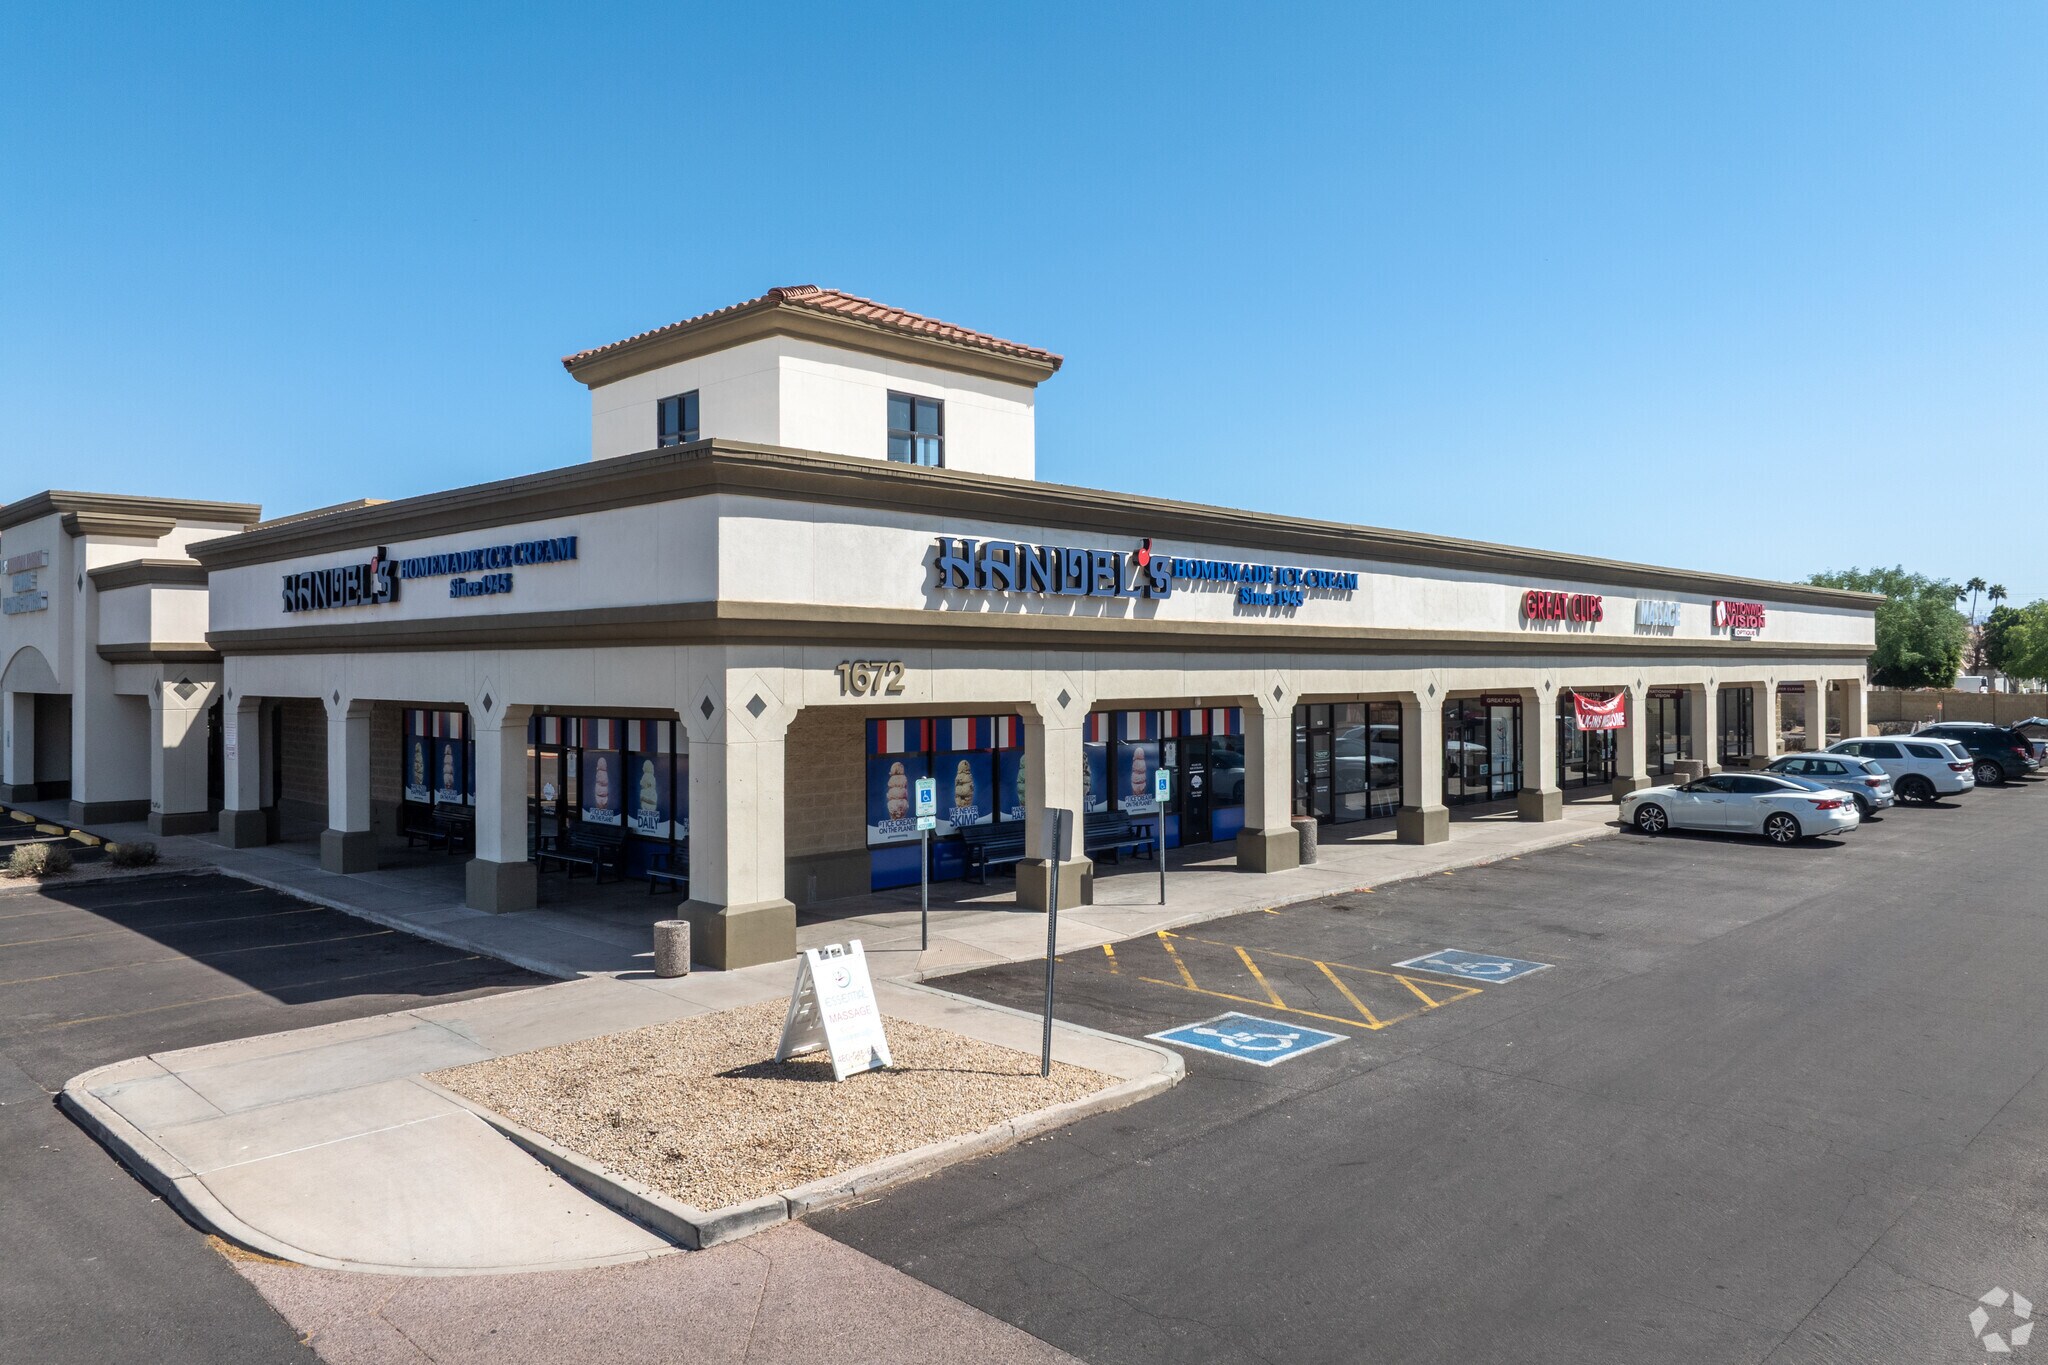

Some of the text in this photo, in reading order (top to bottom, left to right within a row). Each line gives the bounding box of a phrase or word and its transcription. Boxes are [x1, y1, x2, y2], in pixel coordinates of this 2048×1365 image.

[282, 536, 578, 612] HANDEL'S HOMEMADE ICE CREAM
[935, 537, 1359, 600] HANDEL'S HOMEMADE ICE CREAM
[449, 573, 513, 598] Since 1945
[1238, 587, 1304, 607] Since 1945
[1523, 590, 1604, 623] GREAT CLIPS
[1640, 600, 1681, 626] MASSAGE
[1726, 601, 1766, 615] NATIONWIDE
[1726, 614, 1766, 628] VISION
[836, 660, 906, 693] 1672
[949, 805, 979, 815] WE NEVER
[950, 813, 979, 827] SKIMP
[637, 815, 659, 830] DAILY
[886, 819, 898, 828] ICE
[897, 825, 916, 833] PLANET
[828, 1005, 872, 1025] MASSAGE
